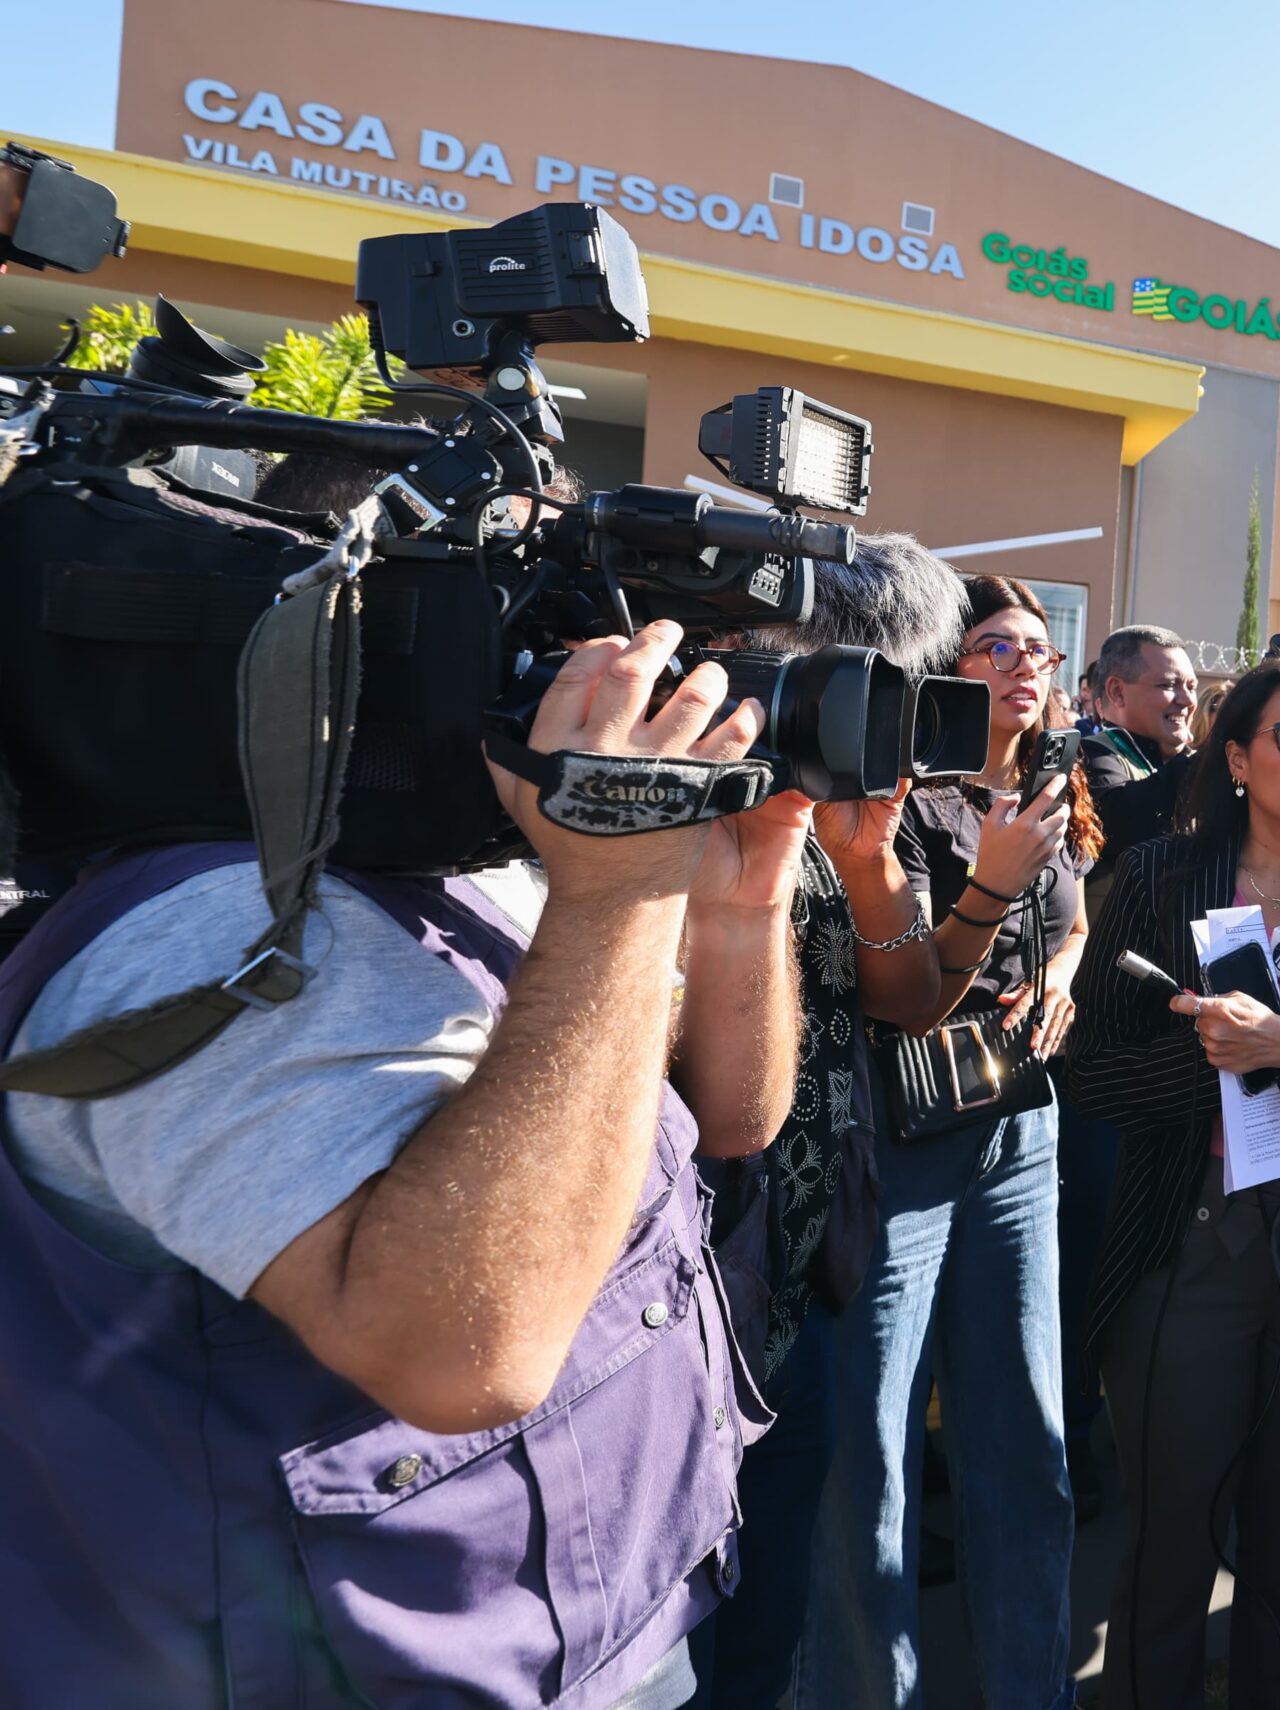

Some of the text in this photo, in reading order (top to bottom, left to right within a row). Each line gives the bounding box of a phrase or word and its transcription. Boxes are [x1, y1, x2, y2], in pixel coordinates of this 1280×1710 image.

[183, 134, 468, 212] VILA MUTIRÃO
[184, 78, 966, 279] CASA DA PESSOA IDOSA
[489, 262, 526, 273] prolite
[1007, 269, 1115, 312] social
[583, 779, 687, 802] Canon
